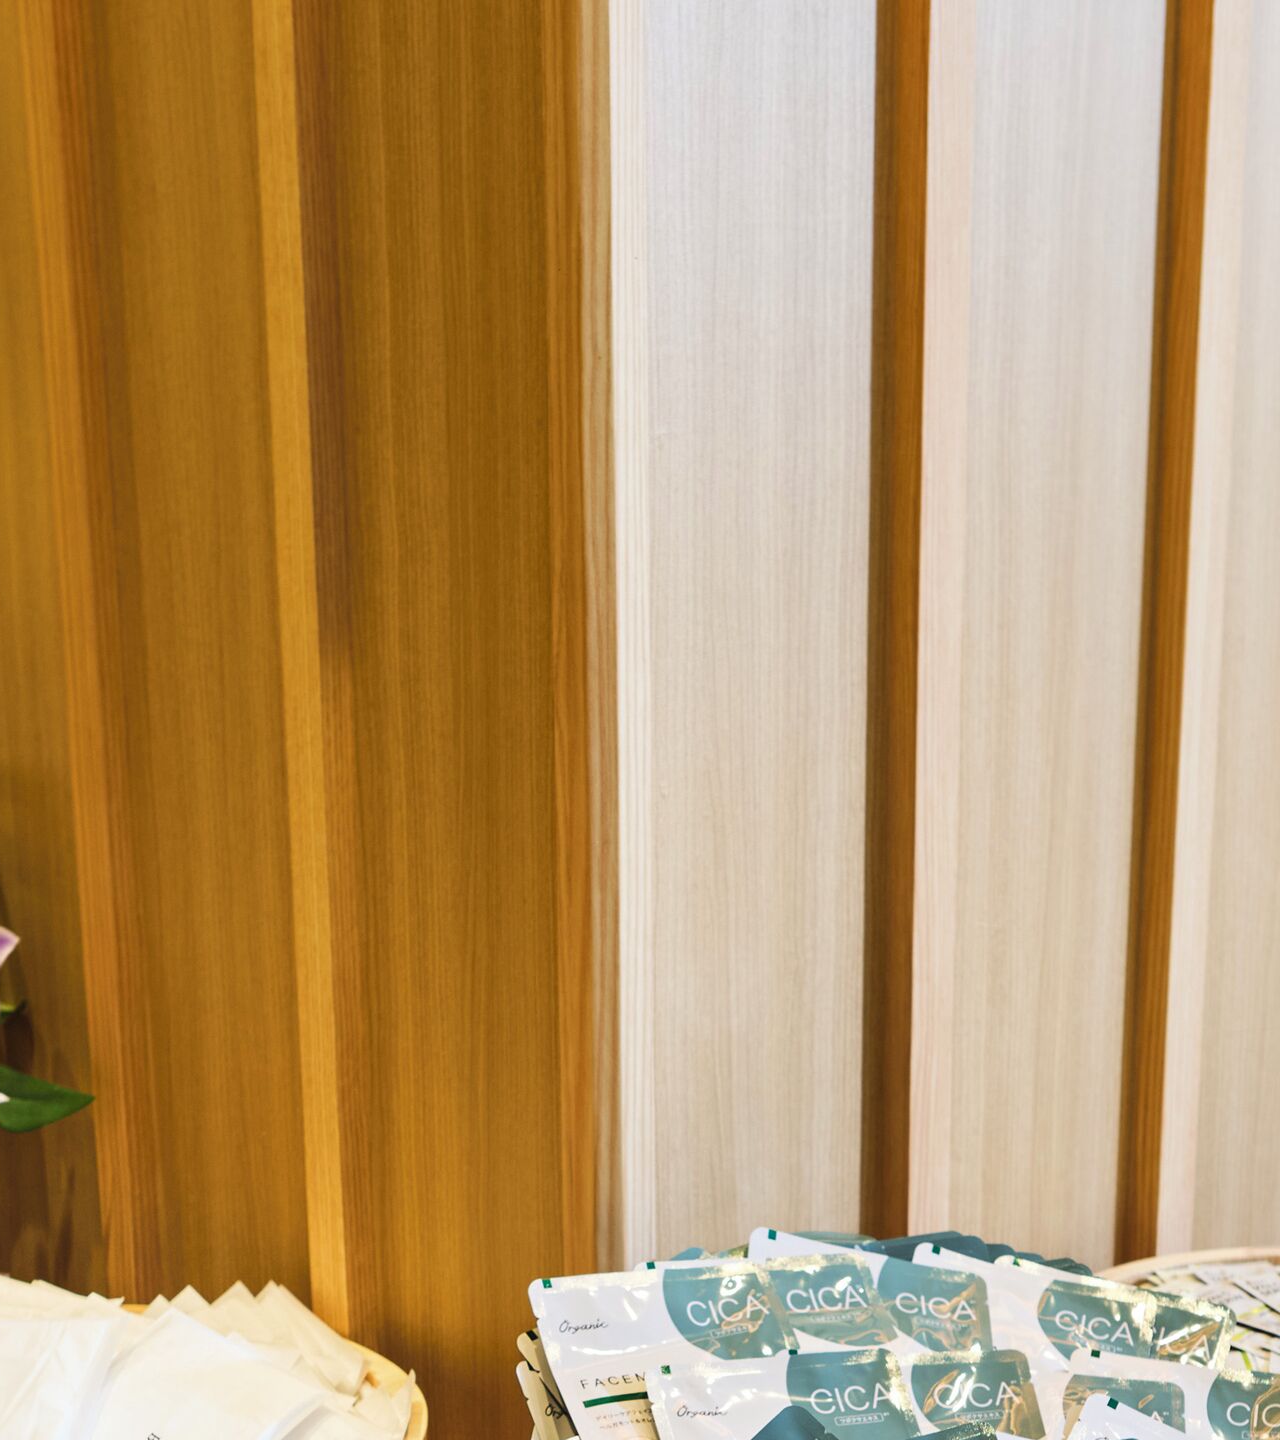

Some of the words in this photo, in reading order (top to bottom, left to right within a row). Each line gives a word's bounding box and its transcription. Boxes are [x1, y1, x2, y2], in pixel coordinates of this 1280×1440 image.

[686, 1293, 770, 1327] CICA
[786, 1284, 867, 1314] CICA
[895, 1291, 977, 1322] CICA
[558, 1318, 609, 1335] Organic
[1055, 1309, 1134, 1347] CICA
[580, 1371, 645, 1389] FACEM
[810, 1382, 893, 1415] CICA
[933, 1381, 1017, 1410] CICA
[677, 1404, 728, 1419] Organic
